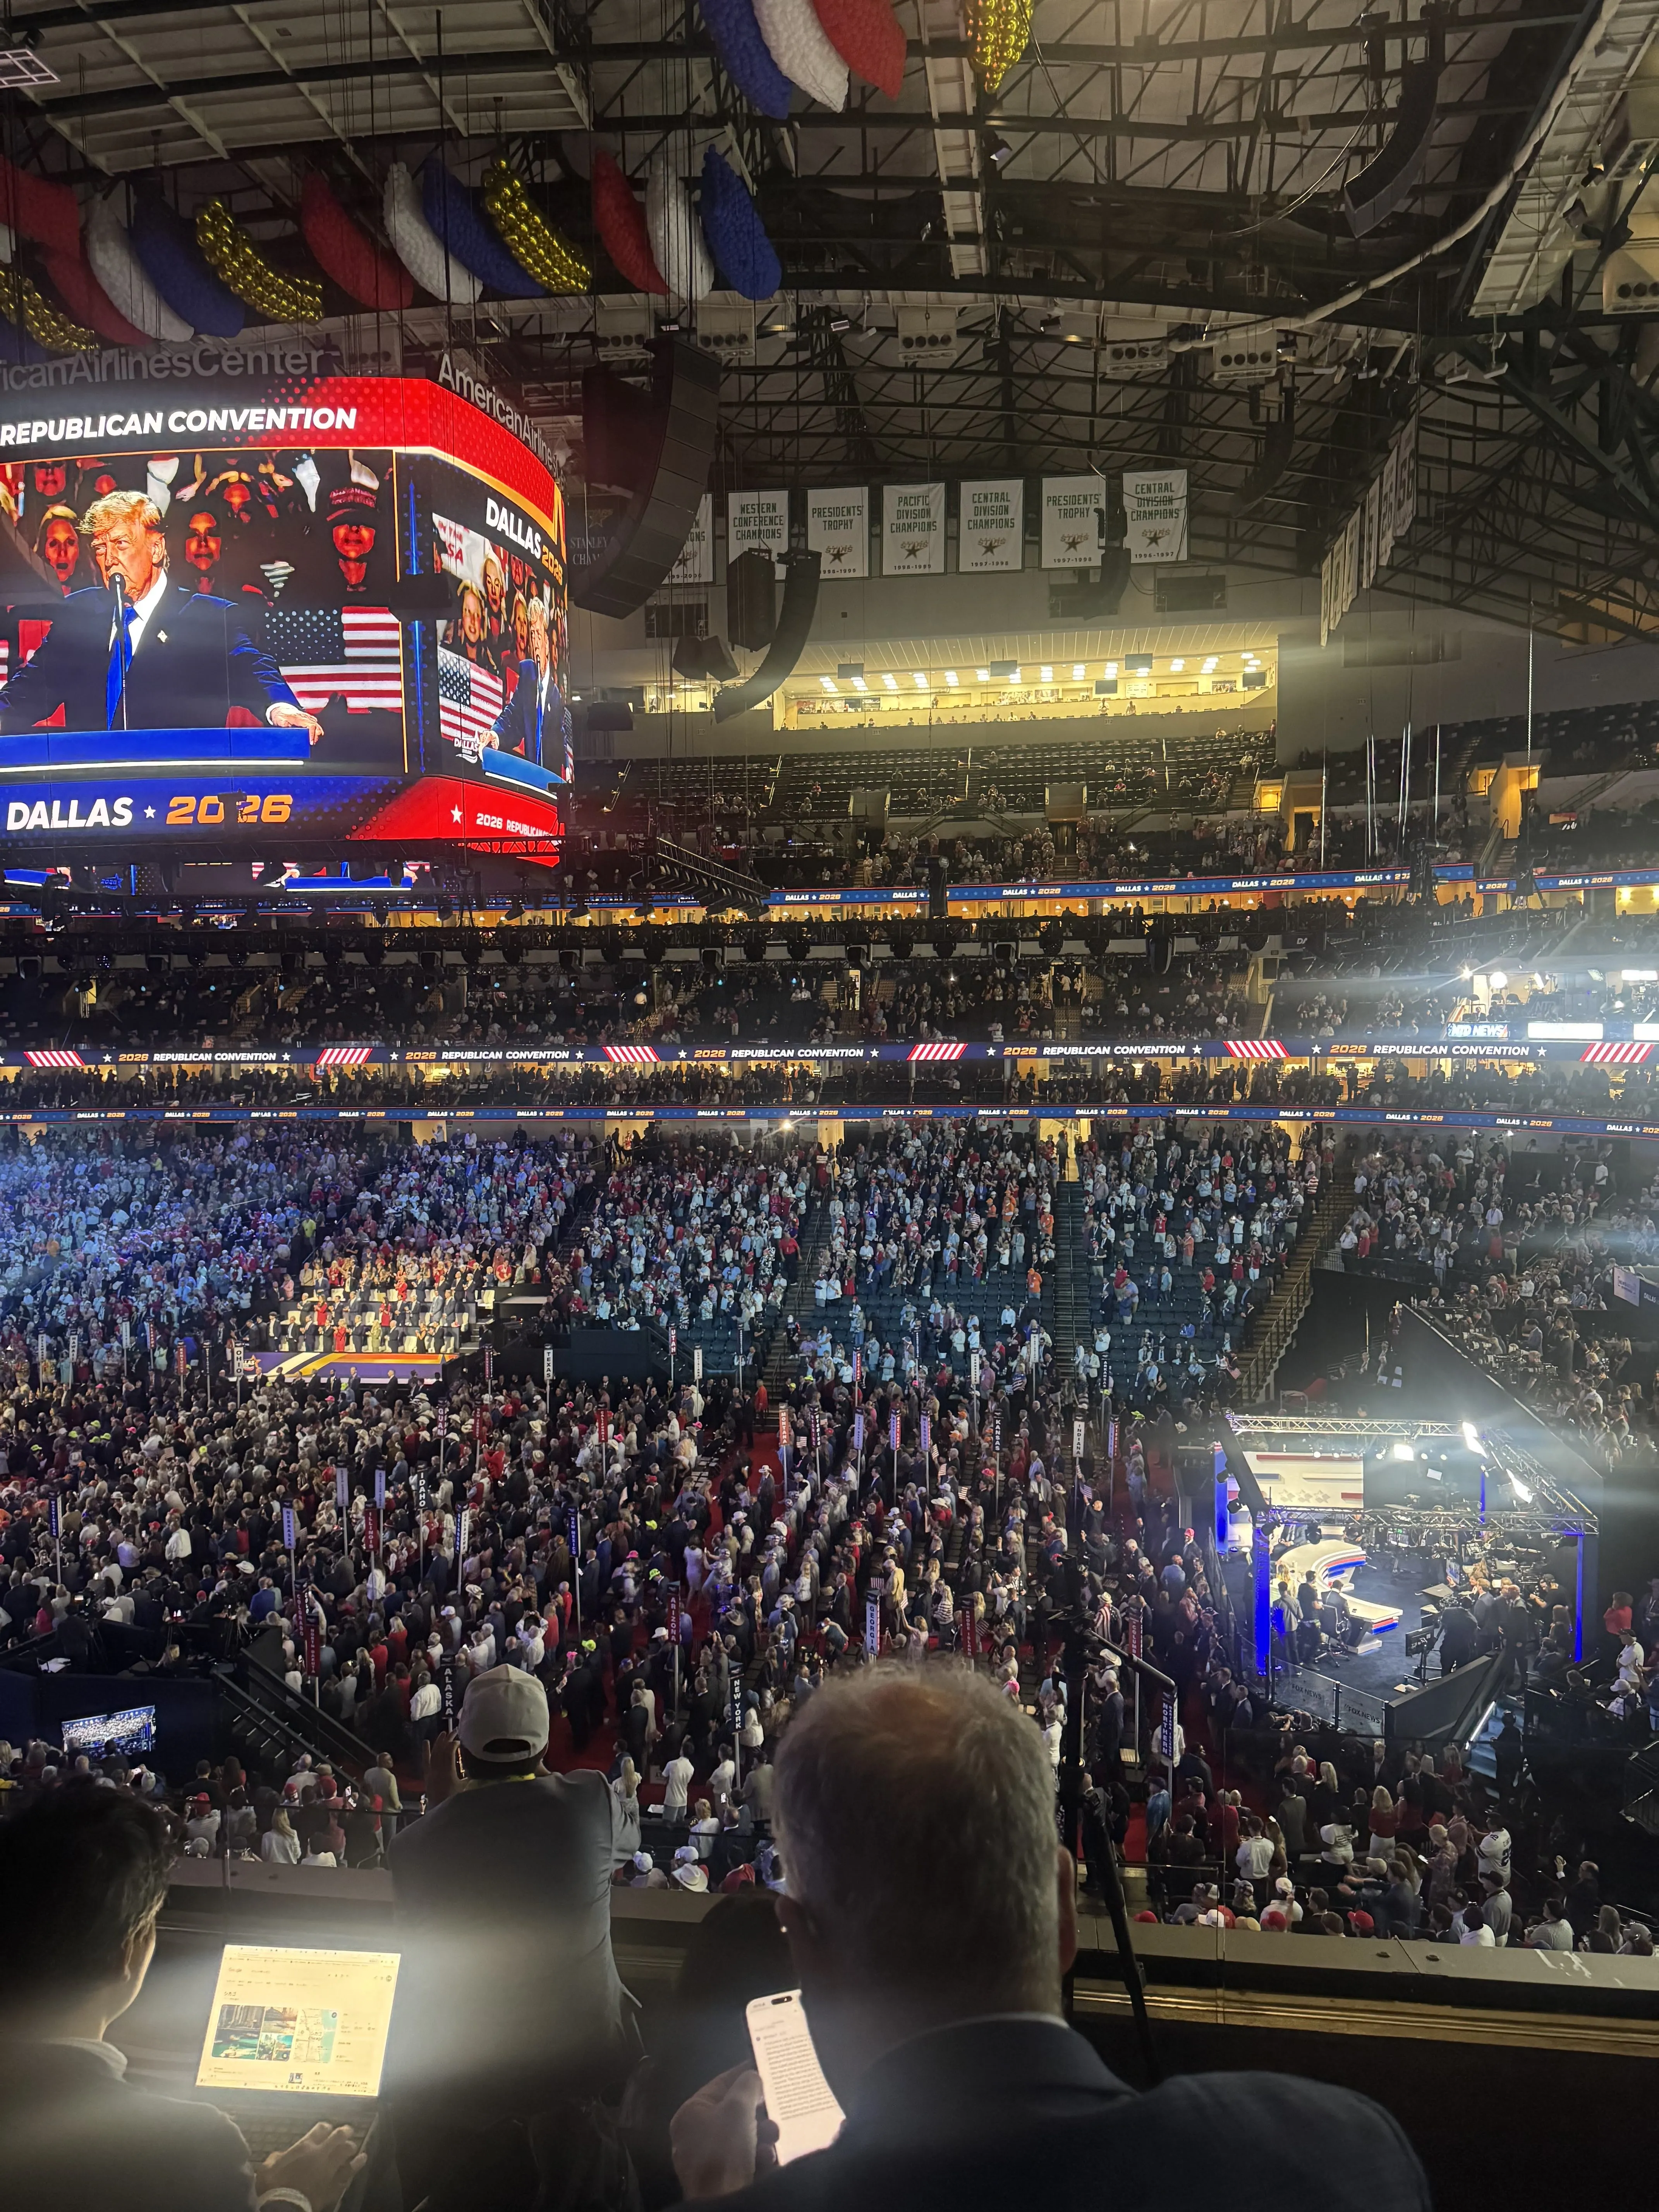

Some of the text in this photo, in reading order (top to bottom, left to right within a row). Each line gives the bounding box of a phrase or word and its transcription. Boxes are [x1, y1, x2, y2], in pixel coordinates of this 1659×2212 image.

[0, 345, 324, 390] icanAirlinesCenter
[0, 408, 357, 446] REPUBLICAN CONVENTION
[1135, 483, 1175, 494] CENTRAL
[898, 495, 929, 507] PACIFIC
[972, 492, 1010, 503] CENTRAL
[1047, 494, 1101, 506] PRESIDENTS'
[1137, 495, 1173, 508] DIVISION
[740, 503, 776, 514] WESTERN
[896, 508, 931, 519] DIVISION
[974, 505, 1008, 517] DIVISION
[1058, 507, 1090, 519] TROPHY
[1131, 508, 1179, 521] CHAMPIONS
[733, 515, 784, 527] CONFERENCE
[823, 519, 854, 531] TROPHY
[890, 521, 937, 533] CHAMPIONS
[968, 518, 1015, 530] CHAMPIONS
[736, 529, 781, 541] CHAMPIONS
[486, 497, 541, 559] DALLAS
[542, 545, 563, 586] 2026
[7, 795, 293, 830] DALLAS 2026
[476, 813, 503, 829] 2026
[1453, 1024, 1504, 1036] NTD NEWS
[1043, 1046, 1110, 1054] REPUBLICAN
[1114, 1046, 1185, 1054] CONVENTION
[1373, 1045, 1448, 1054] REPUBLICAN
[1452, 1046, 1529, 1055] CONVENTION
[444, 1668, 453, 1715] ALASKA
[1292, 1683, 1322, 1700] FOX NEWS
[1348, 1706, 1380, 1723] FOX NEWS
